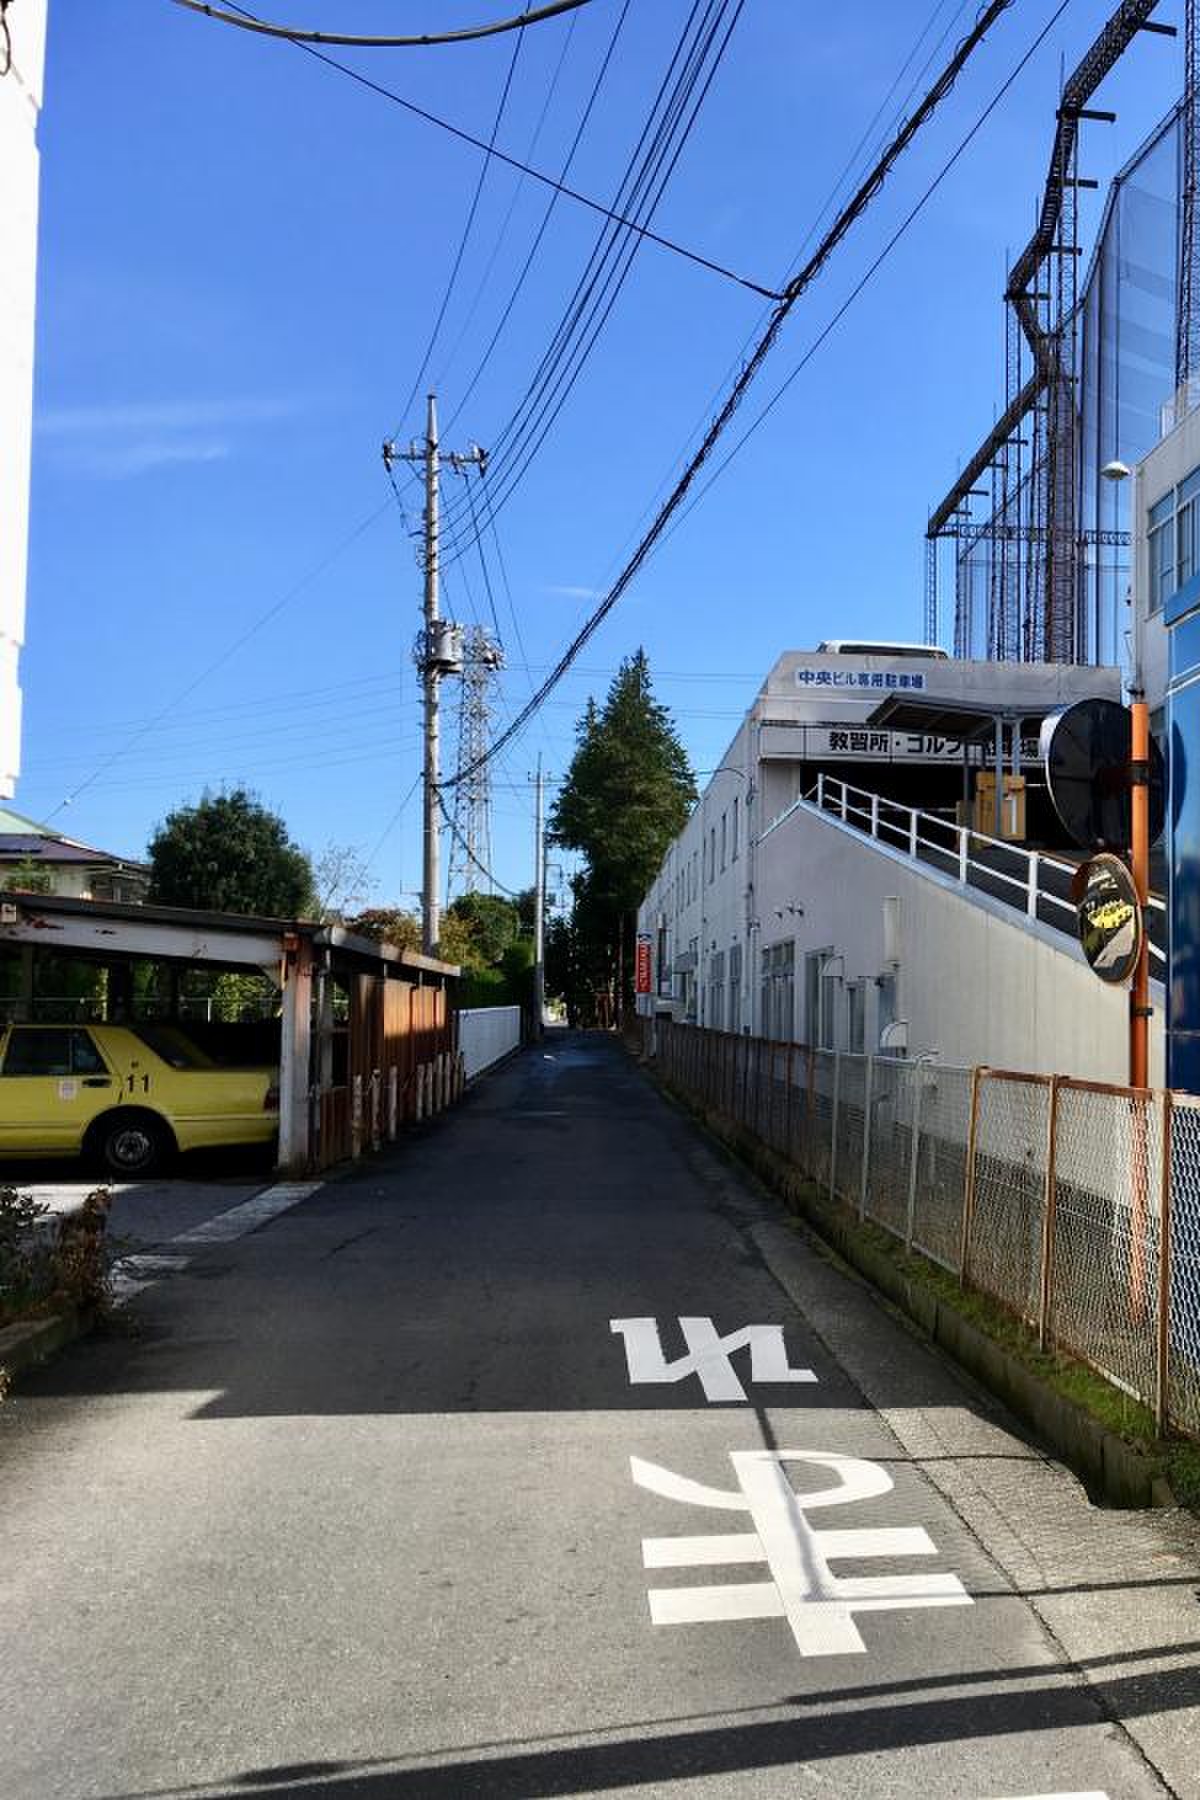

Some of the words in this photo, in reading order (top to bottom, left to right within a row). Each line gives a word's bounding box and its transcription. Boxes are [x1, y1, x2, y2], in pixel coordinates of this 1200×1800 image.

[799, 670, 923, 689] 中央ビル専用駐車場
[126, 1073, 149, 1093] 11
